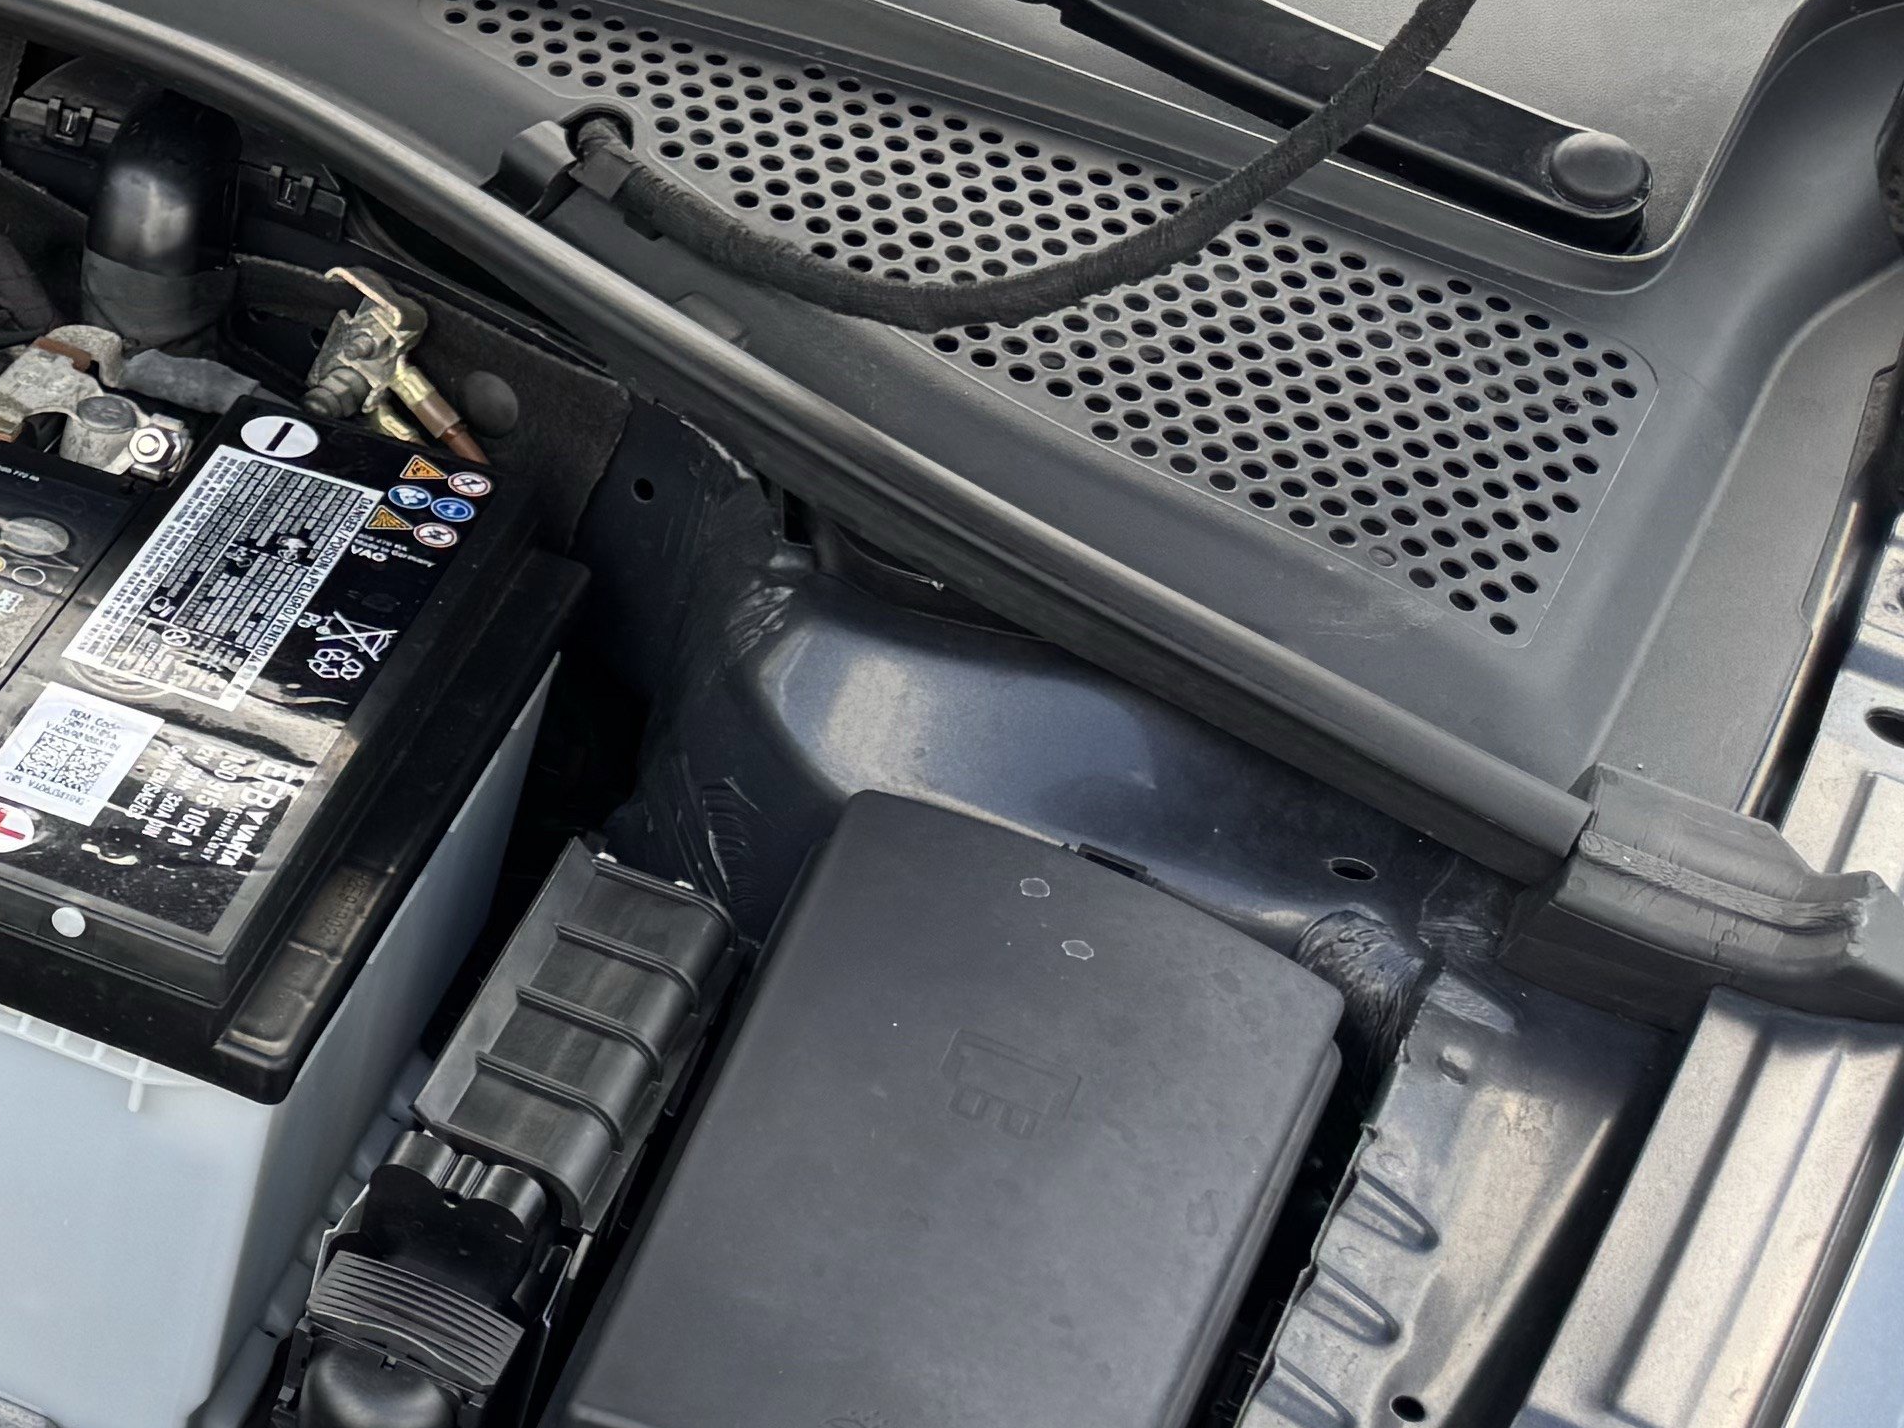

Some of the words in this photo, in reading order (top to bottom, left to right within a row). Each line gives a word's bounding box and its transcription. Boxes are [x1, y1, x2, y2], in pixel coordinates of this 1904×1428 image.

[177, 806, 211, 837] 105
[168, 831, 193, 847] A
[217, 824, 260, 866] VARTA
